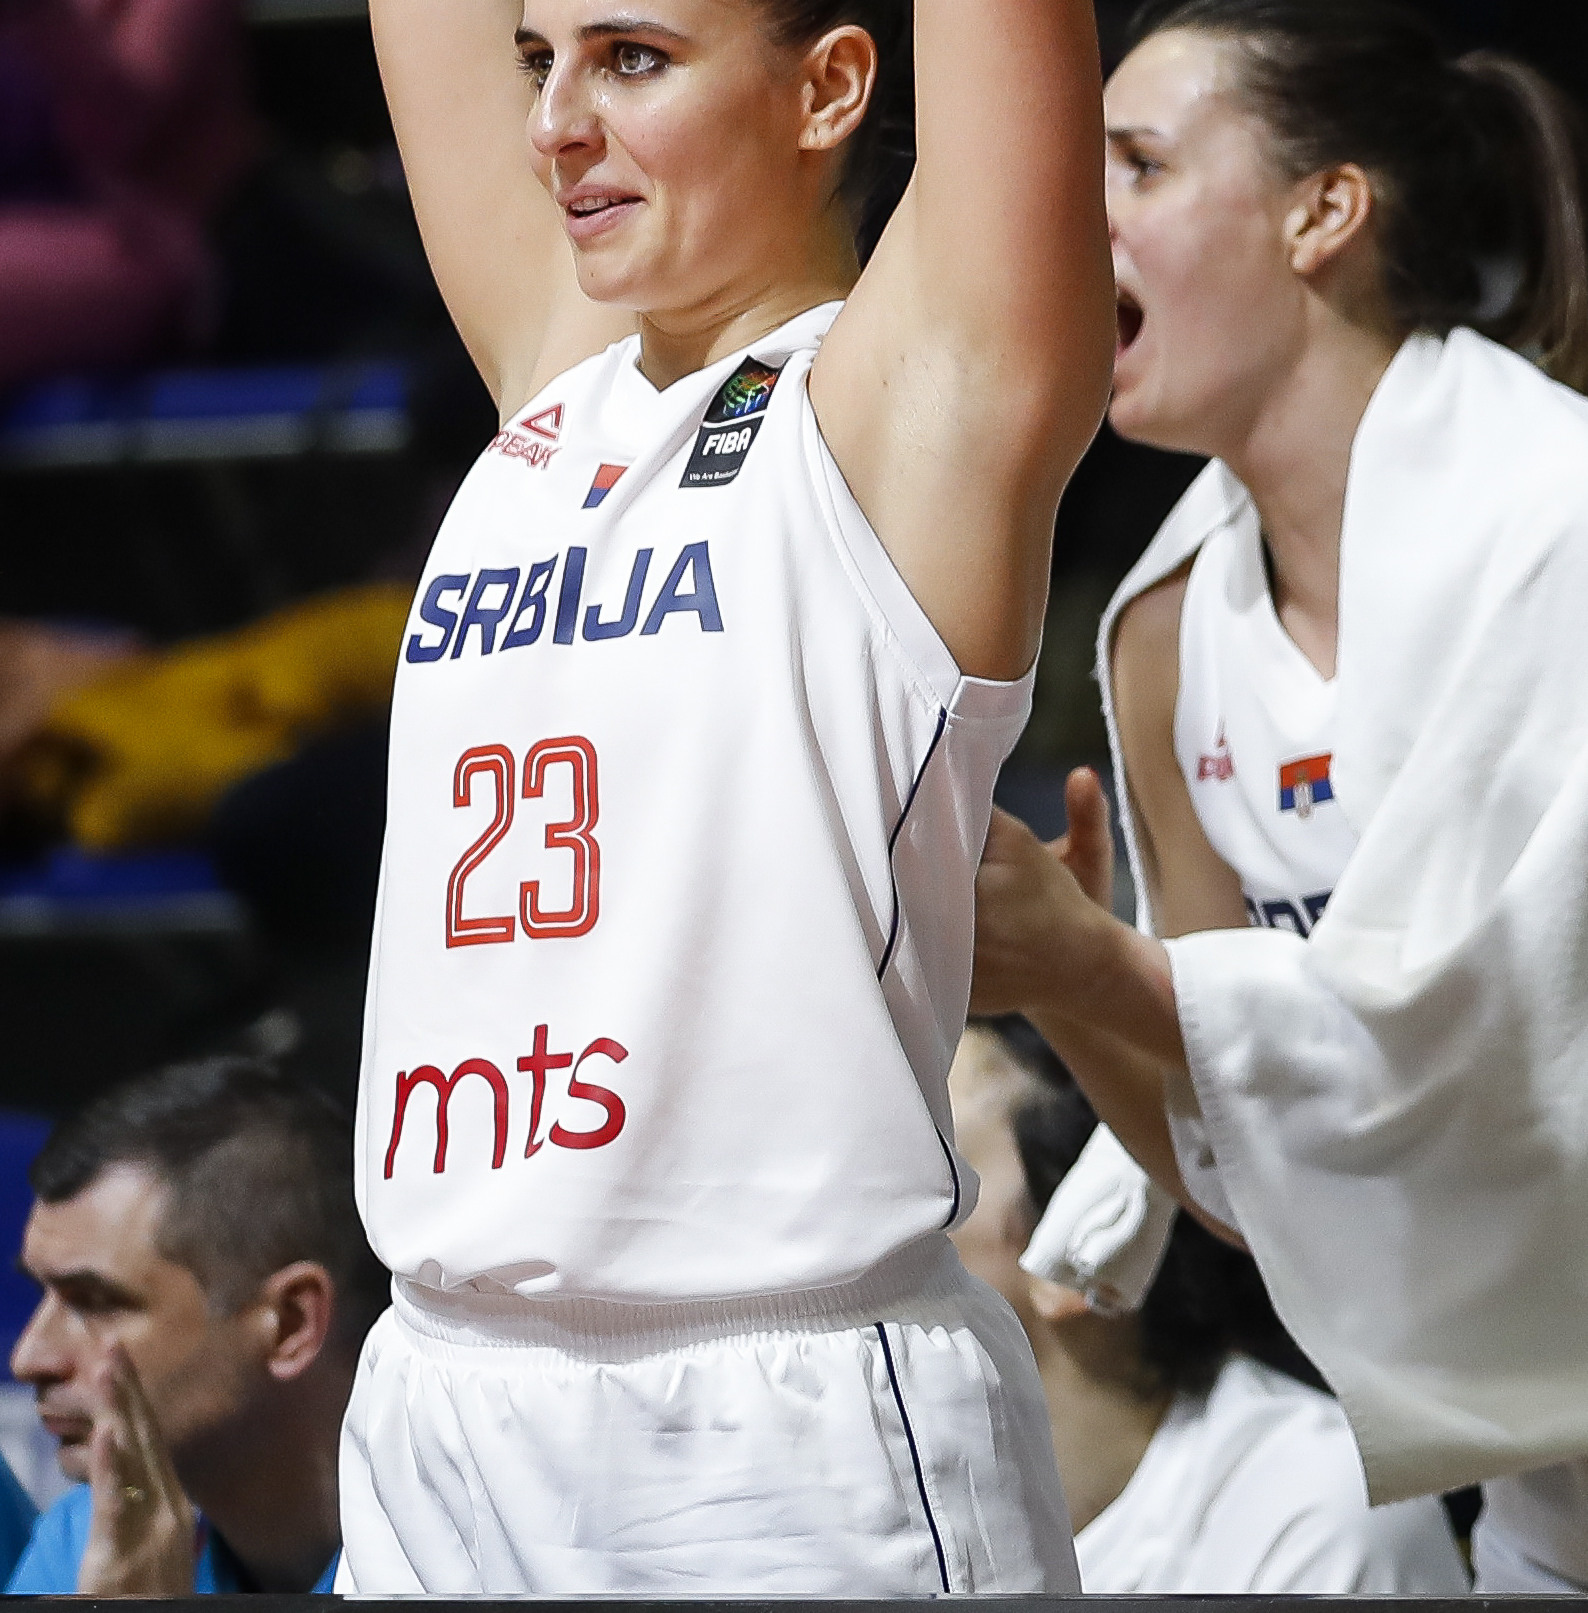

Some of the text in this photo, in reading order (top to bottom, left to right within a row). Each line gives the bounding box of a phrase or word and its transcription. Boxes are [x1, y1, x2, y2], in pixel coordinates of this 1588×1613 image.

[702, 427, 752, 456] FIBA
[405, 540, 724, 664] SRBIJA
[446, 735, 600, 949] 23
[384, 1024, 629, 1180] mts
